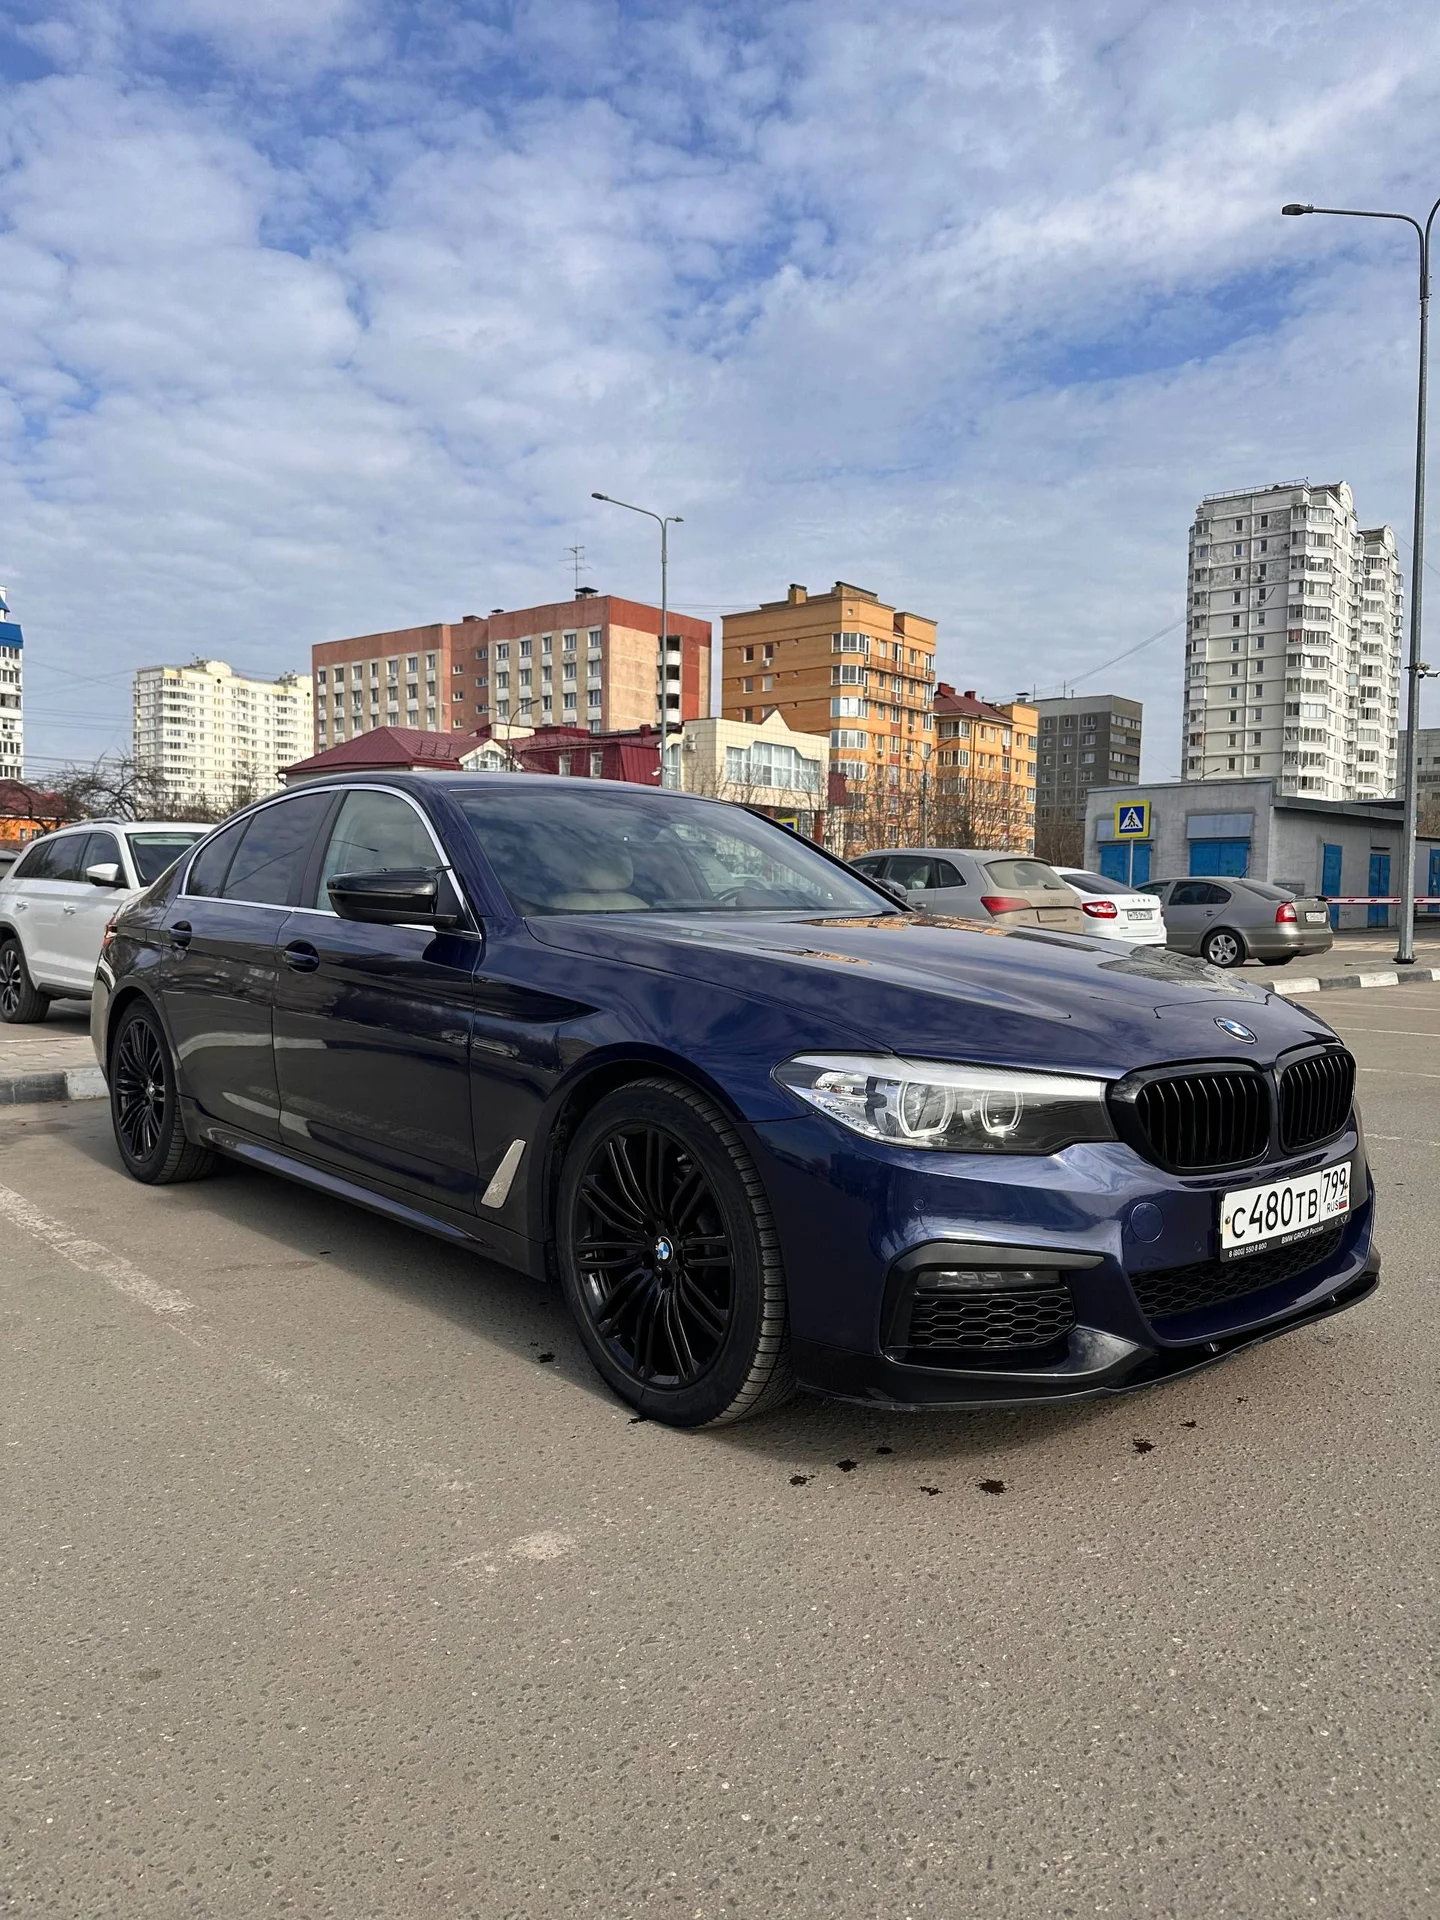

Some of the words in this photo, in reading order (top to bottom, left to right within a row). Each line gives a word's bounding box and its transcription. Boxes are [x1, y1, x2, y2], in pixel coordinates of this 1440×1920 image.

[1232, 1187, 1318, 1239] С480ТВ
[1323, 1167, 1346, 1204] 799
[1327, 1201, 1339, 1214] RUS
[1281, 1234, 1294, 1244] BMW
[1293, 1229, 1309, 1240] GROUP
